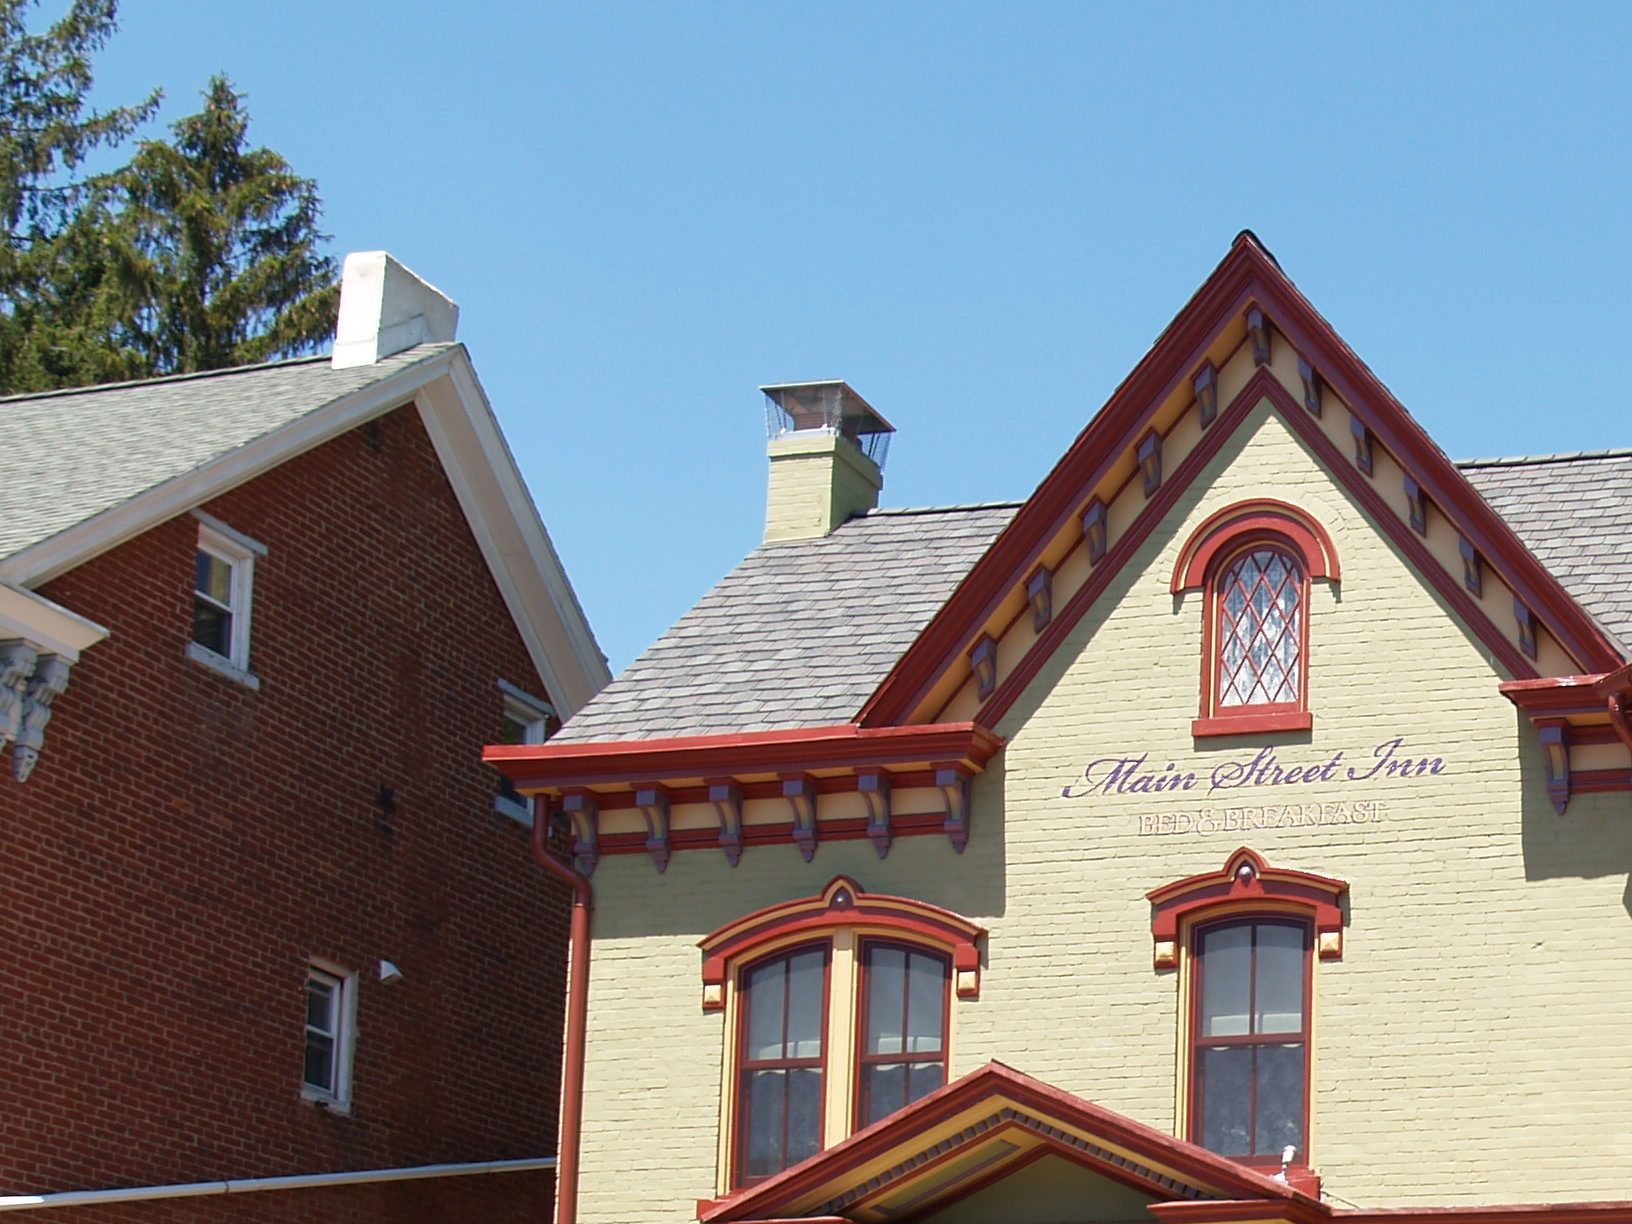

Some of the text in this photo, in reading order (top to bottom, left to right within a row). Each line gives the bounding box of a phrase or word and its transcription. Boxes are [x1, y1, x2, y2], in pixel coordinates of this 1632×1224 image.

[1061, 737, 1448, 799] Main Street Inn
[1138, 813, 1195, 837] BED
[1223, 800, 1387, 832] BREAKFAST
